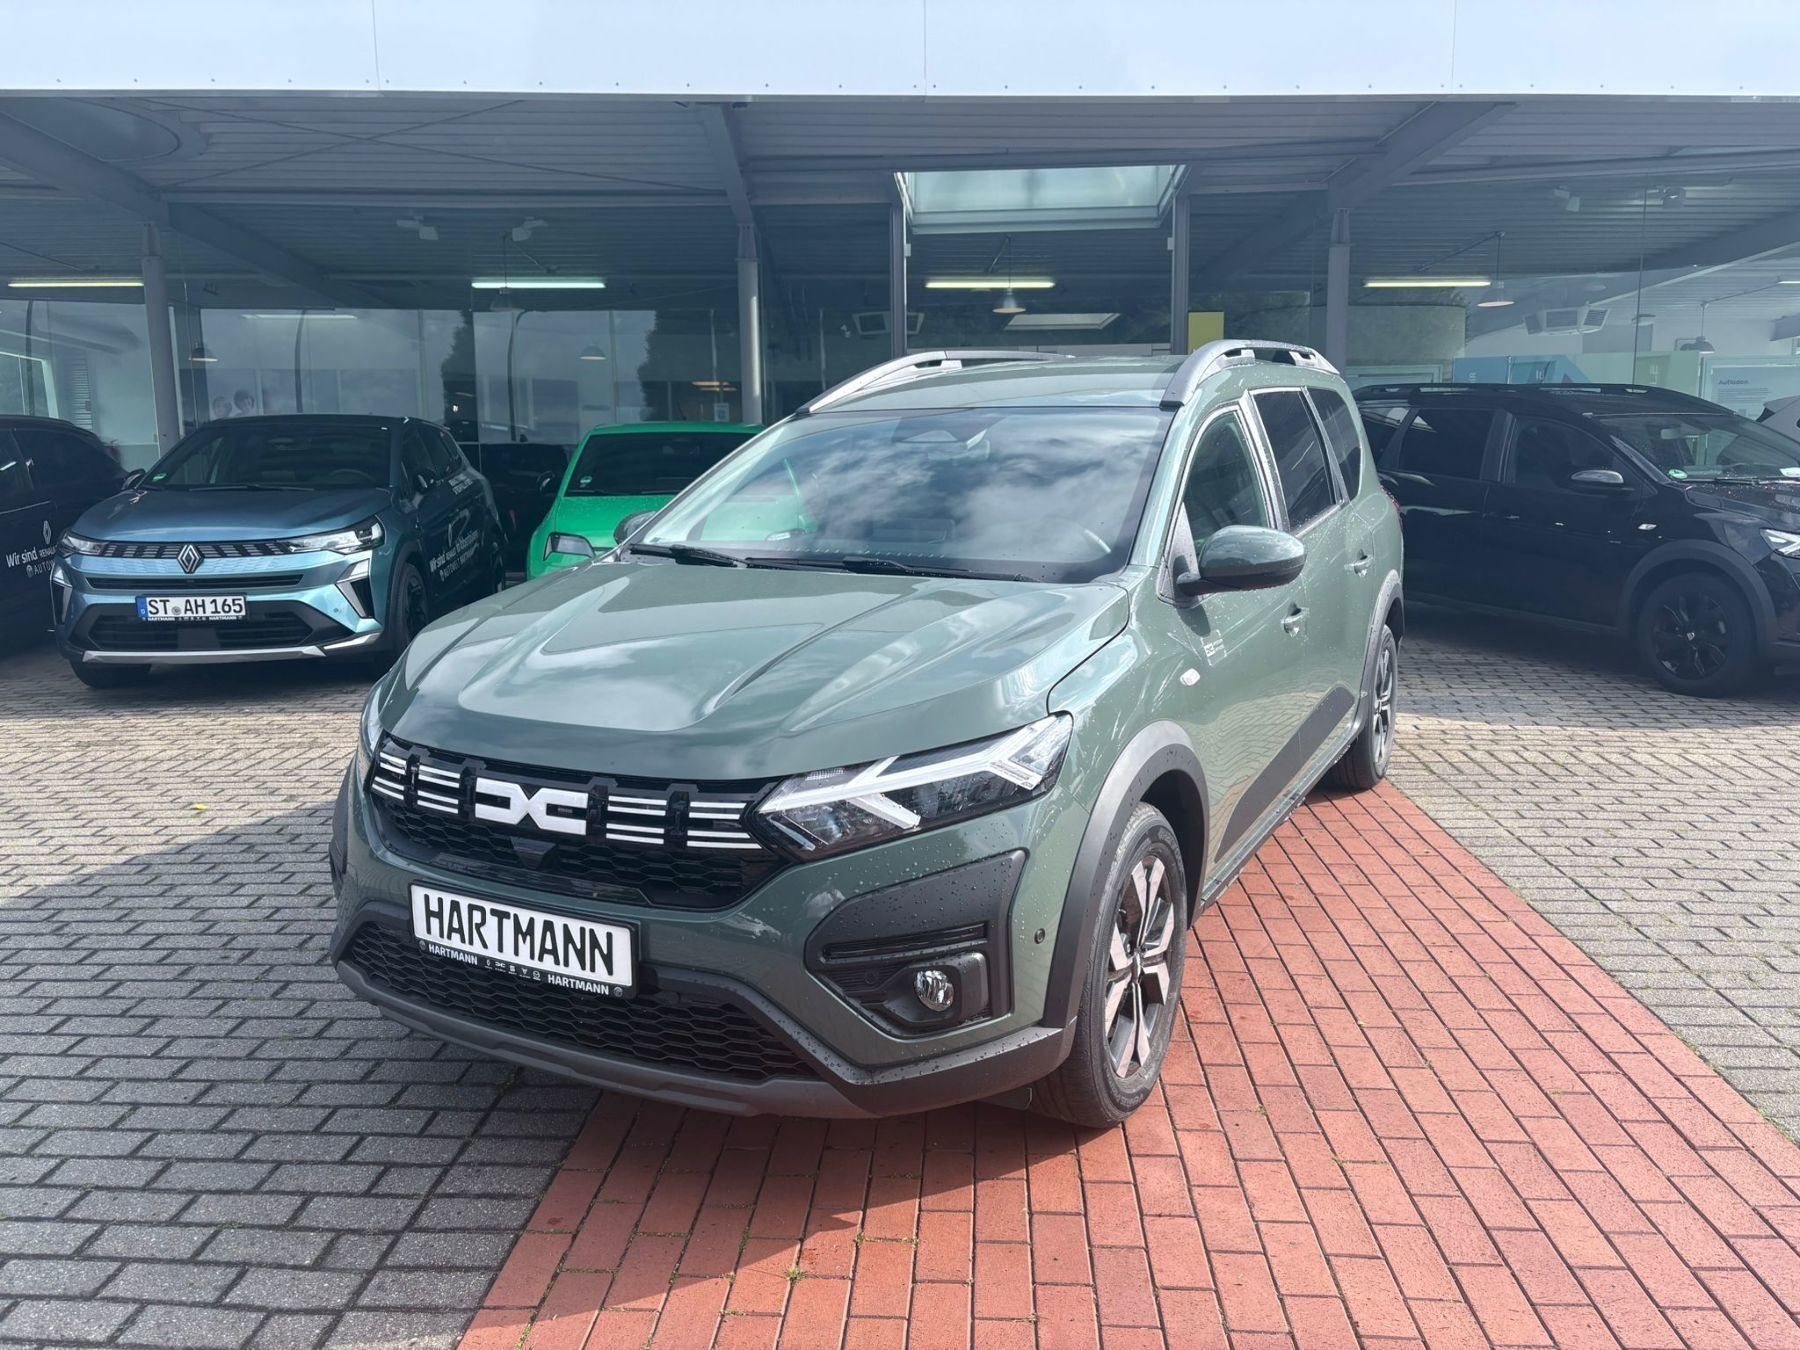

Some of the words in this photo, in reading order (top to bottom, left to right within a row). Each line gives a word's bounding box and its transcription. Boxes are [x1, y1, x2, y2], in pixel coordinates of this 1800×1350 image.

[5, 552, 20, 568] Wir
[21, 546, 38, 563] sind
[148, 599, 170, 615] ST
[184, 598, 206, 615] AH
[210, 598, 243, 615] 165
[424, 893, 614, 976] HARTMANN
[428, 943, 478, 966] HARTMANN
[547, 974, 609, 995] HARTMANN
